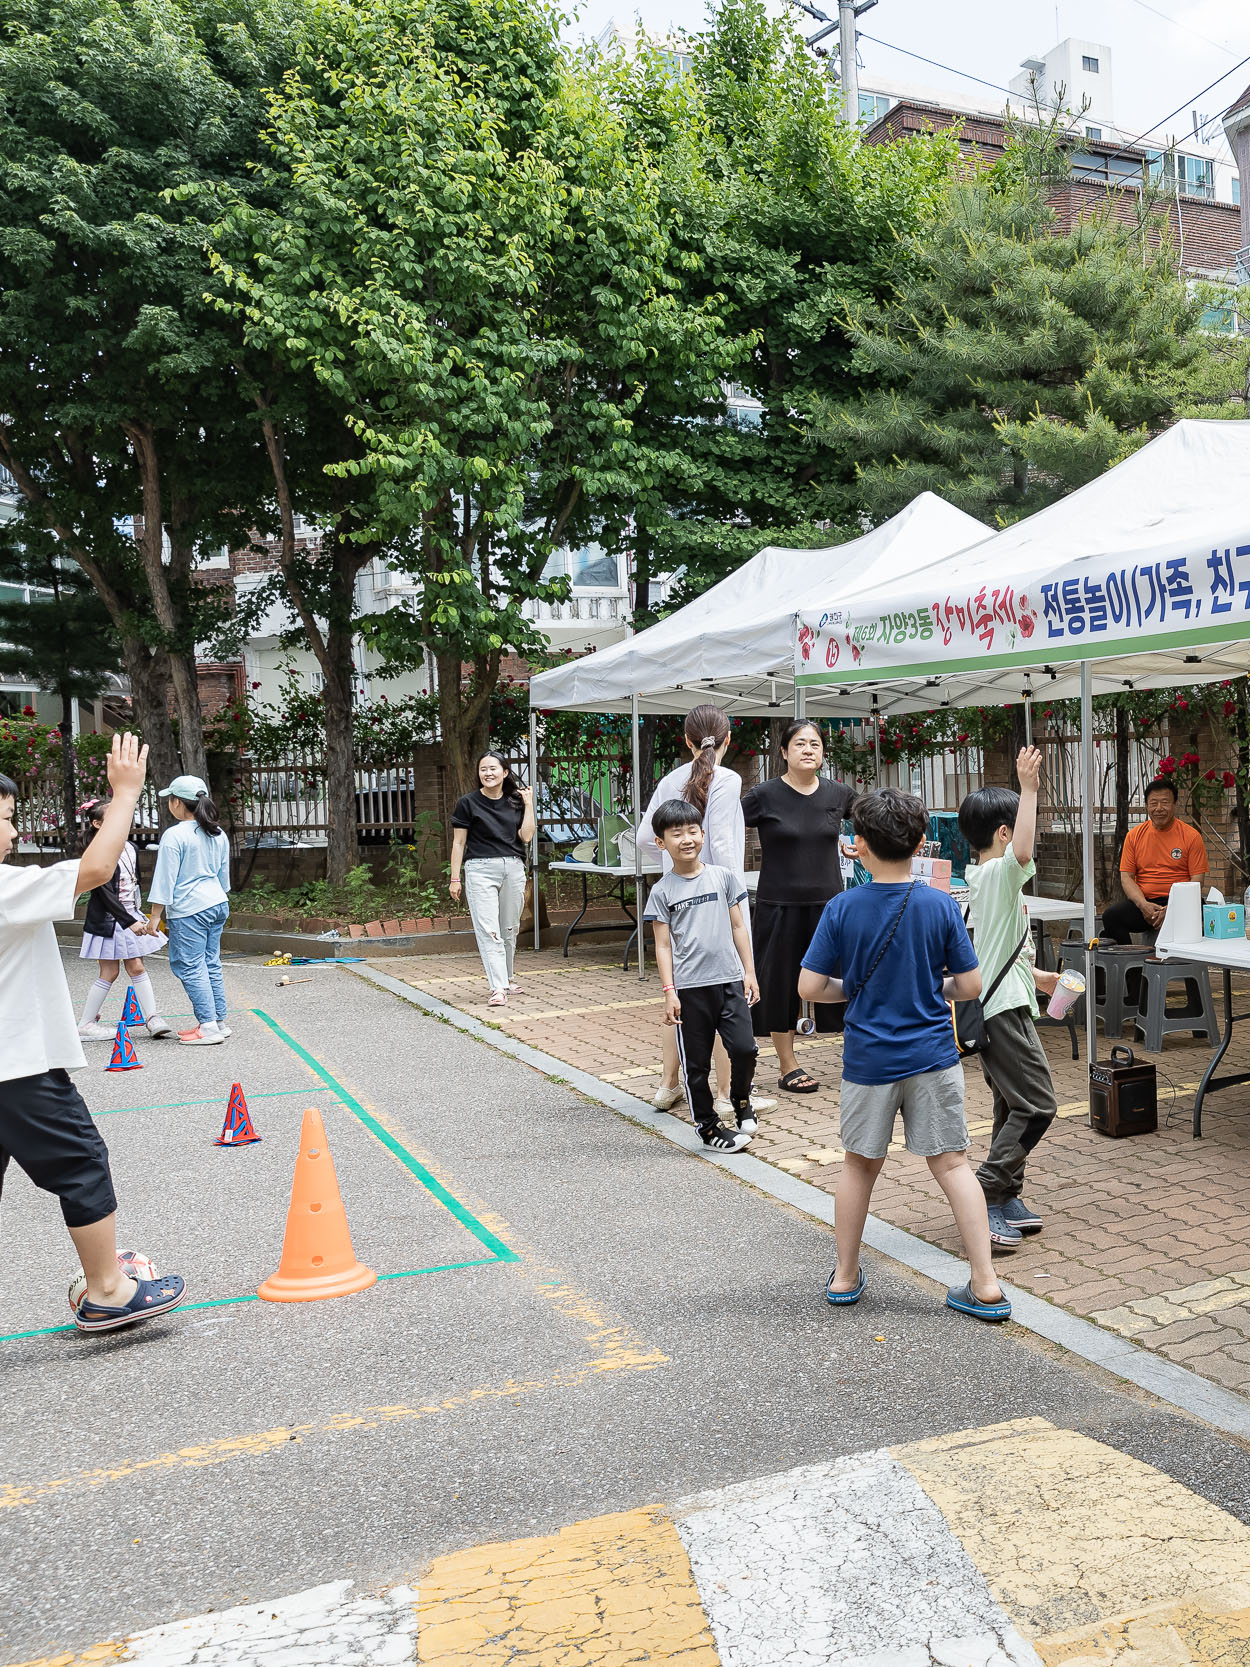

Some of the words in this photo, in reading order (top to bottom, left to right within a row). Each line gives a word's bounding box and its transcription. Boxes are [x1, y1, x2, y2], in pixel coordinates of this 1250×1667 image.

[852, 623, 878, 643] 제6회
[877, 607, 934, 644] 자양3동
[932, 585, 1017, 651] 장미축제
[1040, 557, 1202, 639] 전통놀이(가족,
[674, 900, 690, 912] TAKE
